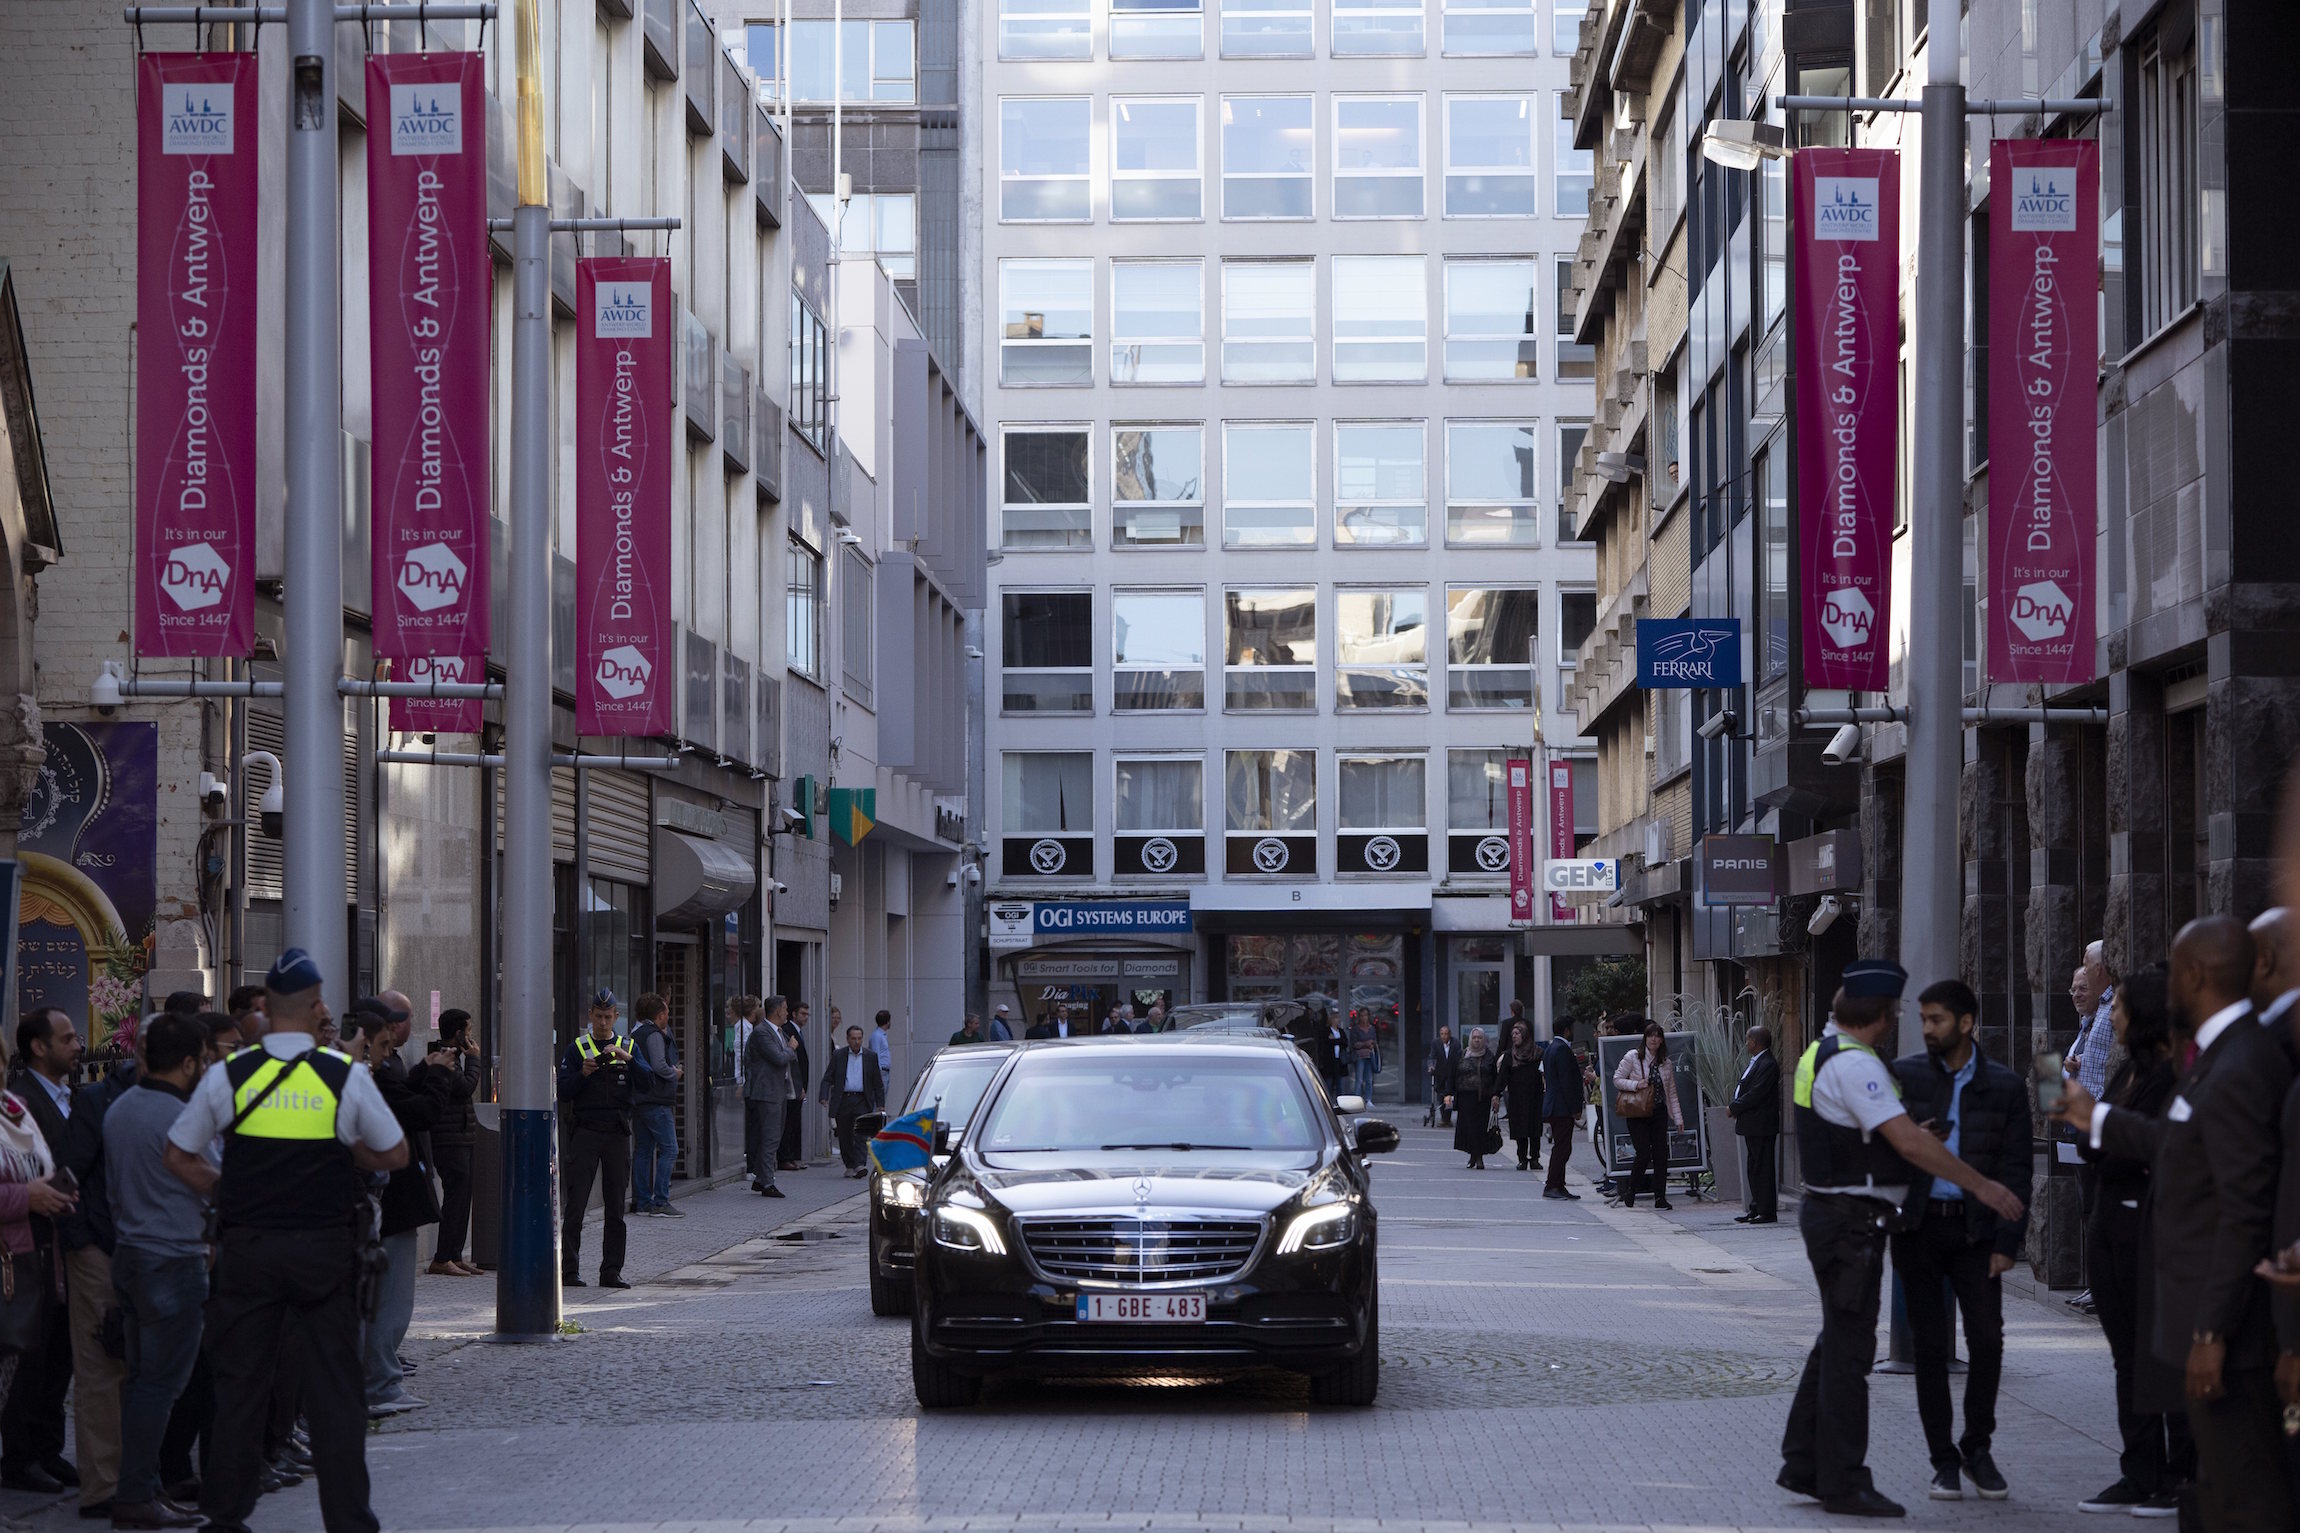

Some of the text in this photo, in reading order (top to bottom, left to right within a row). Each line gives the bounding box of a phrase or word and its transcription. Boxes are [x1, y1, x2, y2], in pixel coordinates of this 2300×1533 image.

[169, 119, 227, 133] AWDC
[397, 118, 455, 134] AWDC
[2018, 199, 2070, 212] AWDC
[1821, 209, 1872, 221] AWDC
[601, 310, 646, 321] AWDC
[180, 170, 215, 511] Diamonds & Antwerp
[413, 170, 444, 511] Diamonds & Antwerp
[2027, 246, 2059, 551] Diamonds & Antwerp
[1832, 254, 1862, 558] Diamonds & Antwerp
[611, 350, 637, 620] Diamonds & Antwerp
[165, 528, 227, 540] It's in our
[401, 528, 463, 541] It's in our
[1822, 572, 1872, 585] It's in our
[2013, 567, 2070, 578] It's in our
[159, 614, 230, 626] Since 1447
[397, 613, 468, 627] Since 1447
[599, 633, 613, 643] It's
[617, 634, 627, 643] in
[1821, 649, 1875, 662] Since 1447
[2009, 644, 2073, 655] Since 1447
[1653, 661, 1715, 680] FERRARI
[407, 698, 464, 708] Since 1447
[595, 701, 652, 711] Since 1447
[1558, 791, 1566, 828] Antwerp
[1517, 836, 1525, 882] Diamonds
[1713, 859, 1768, 869] PANIS
[1548, 865, 1606, 887] GEM
[1292, 891, 1302, 901] B
[1040, 908, 1187, 927] OGI SYSTEMS EUROPE
[1039, 963, 1069, 973] Smart
[1072, 963, 1099, 973] Tools
[1100, 962, 1115, 973] for
[1124, 963, 1178, 973] Diamonds
[246, 1087, 324, 1111] Politie
